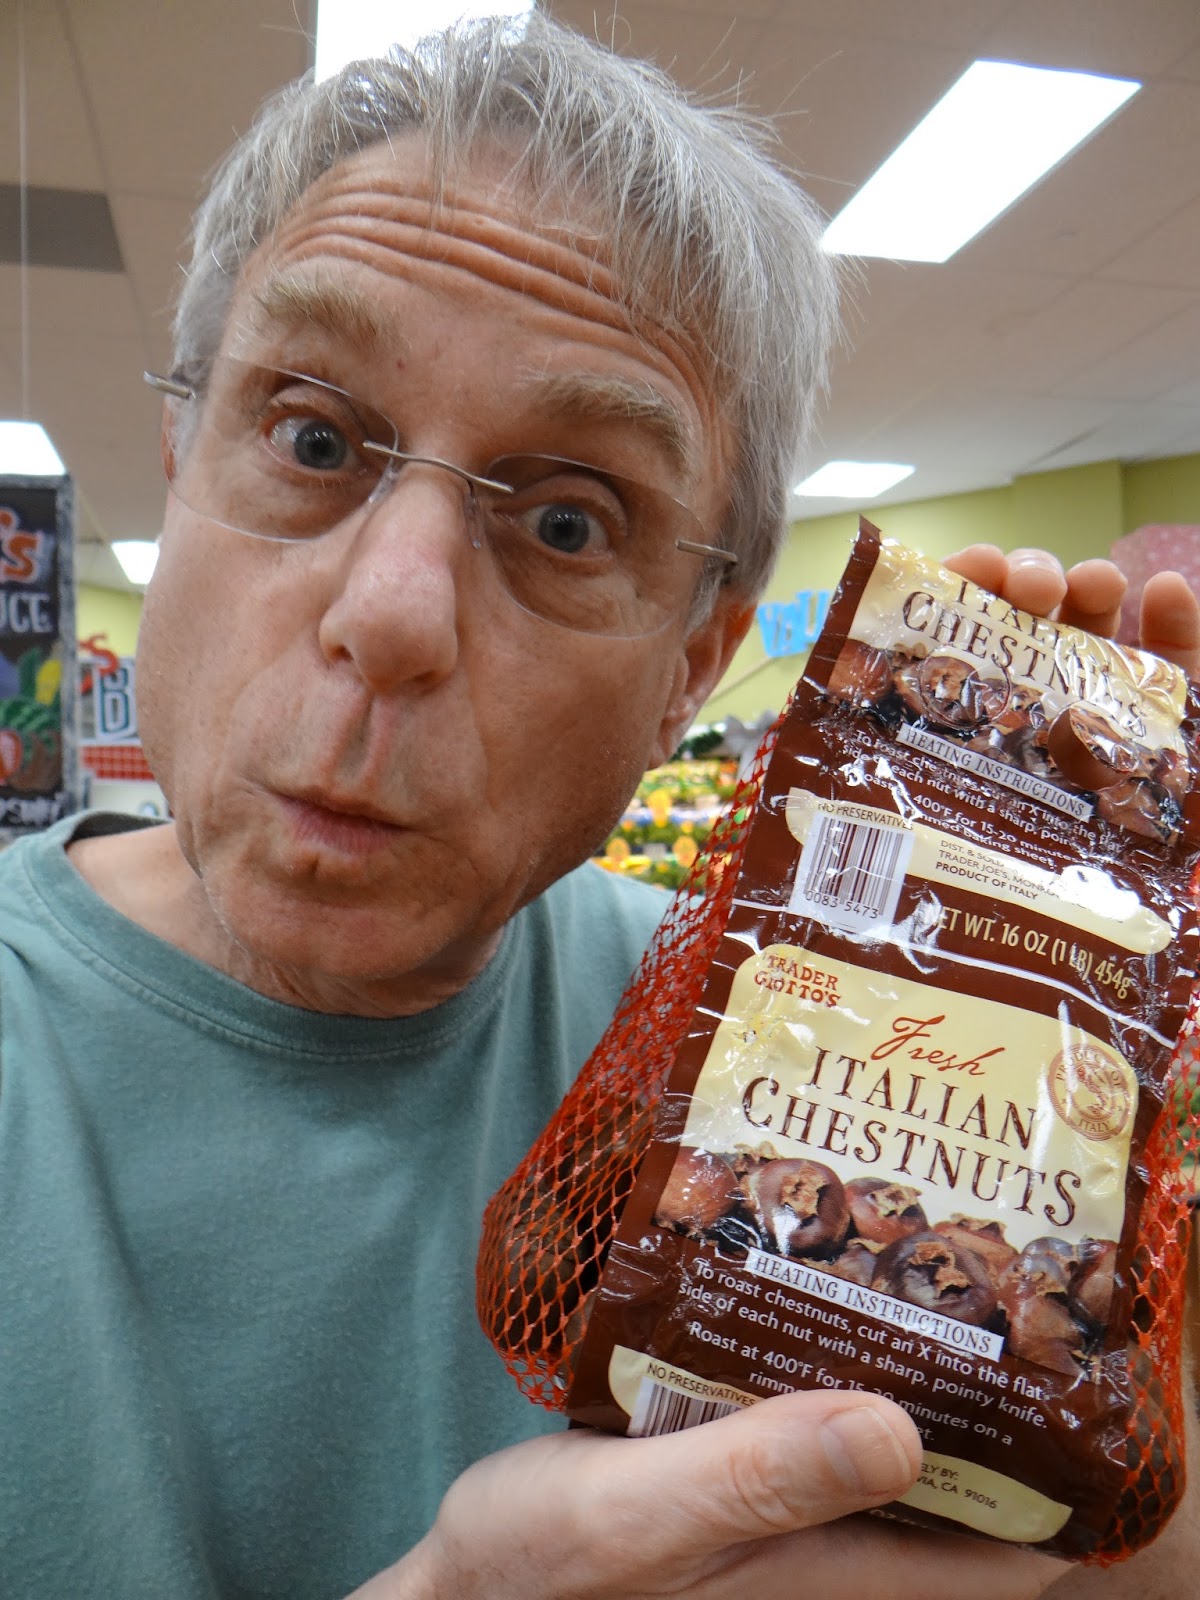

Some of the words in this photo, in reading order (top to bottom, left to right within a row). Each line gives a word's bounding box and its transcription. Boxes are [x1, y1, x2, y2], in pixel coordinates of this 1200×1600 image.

[856, 730, 872, 747] To
[843, 743, 869, 761] side
[891, 764, 924, 784] each
[927, 779, 952, 795] nut
[955, 789, 985, 810] with
[987, 803, 996, 814] a
[906, 728, 972, 766] HEATING
[975, 759, 1085, 816] INSTRUCTIONS
[955, 811, 977, 829] for
[981, 820, 1017, 843] 15-20
[935, 861, 990, 883] PRODUCT
[991, 878, 1007, 891] OF
[1009, 881, 1039, 901] ITALY
[938, 849, 980, 871] TRADER
[805, 890, 838, 908] 0083
[844, 902, 879, 919] 5473
[768, 955, 838, 991] TRADER
[964, 912, 997, 942] WT.
[1001, 923, 1020, 947] 16
[1024, 930, 1049, 956] OZ
[1094, 959, 1132, 1000] 454g
[871, 1014, 1005, 1077] Fresh
[806, 1046, 1037, 1151] ITALIAN
[741, 1075, 1081, 1228] CHESTNUTS
[1078, 1119, 1110, 1132] ITALY
[695, 1262, 714, 1280] To
[717, 1273, 761, 1298] roast
[764, 1288, 852, 1334] chestnuts,
[857, 1324, 888, 1345] cut
[890, 1336, 914, 1354] an
[916, 1342, 933, 1361] X
[934, 1349, 973, 1375] into
[978, 1363, 1009, 1390] the
[755, 1254, 839, 1299] HEATING
[845, 1288, 992, 1353] INSTRUCTIONS
[678, 1281, 712, 1304] side
[715, 1296, 738, 1313] of
[738, 1306, 779, 1330] each
[782, 1321, 814, 1343] nut
[817, 1333, 857, 1359] with
[860, 1350, 871, 1364] a
[874, 1354, 928, 1386] sharp,
[931, 1377, 995, 1407] pointy
[997, 1396, 1048, 1430] knife.
[646, 1362, 667, 1380] NO
[667, 1367, 756, 1406] PRESERVATIVES
[688, 1321, 738, 1352] Roast
[740, 1344, 760, 1361] at
[762, 1351, 814, 1378] 400°F
[815, 1367, 843, 1390] for
[898, 1399, 969, 1429] minutes
[973, 1423, 998, 1439] on
[1002, 1433, 1013, 1446] a
[940, 1469, 960, 1482] BY:
[941, 1482, 959, 1495] CA
[964, 1489, 998, 1509] 91016
